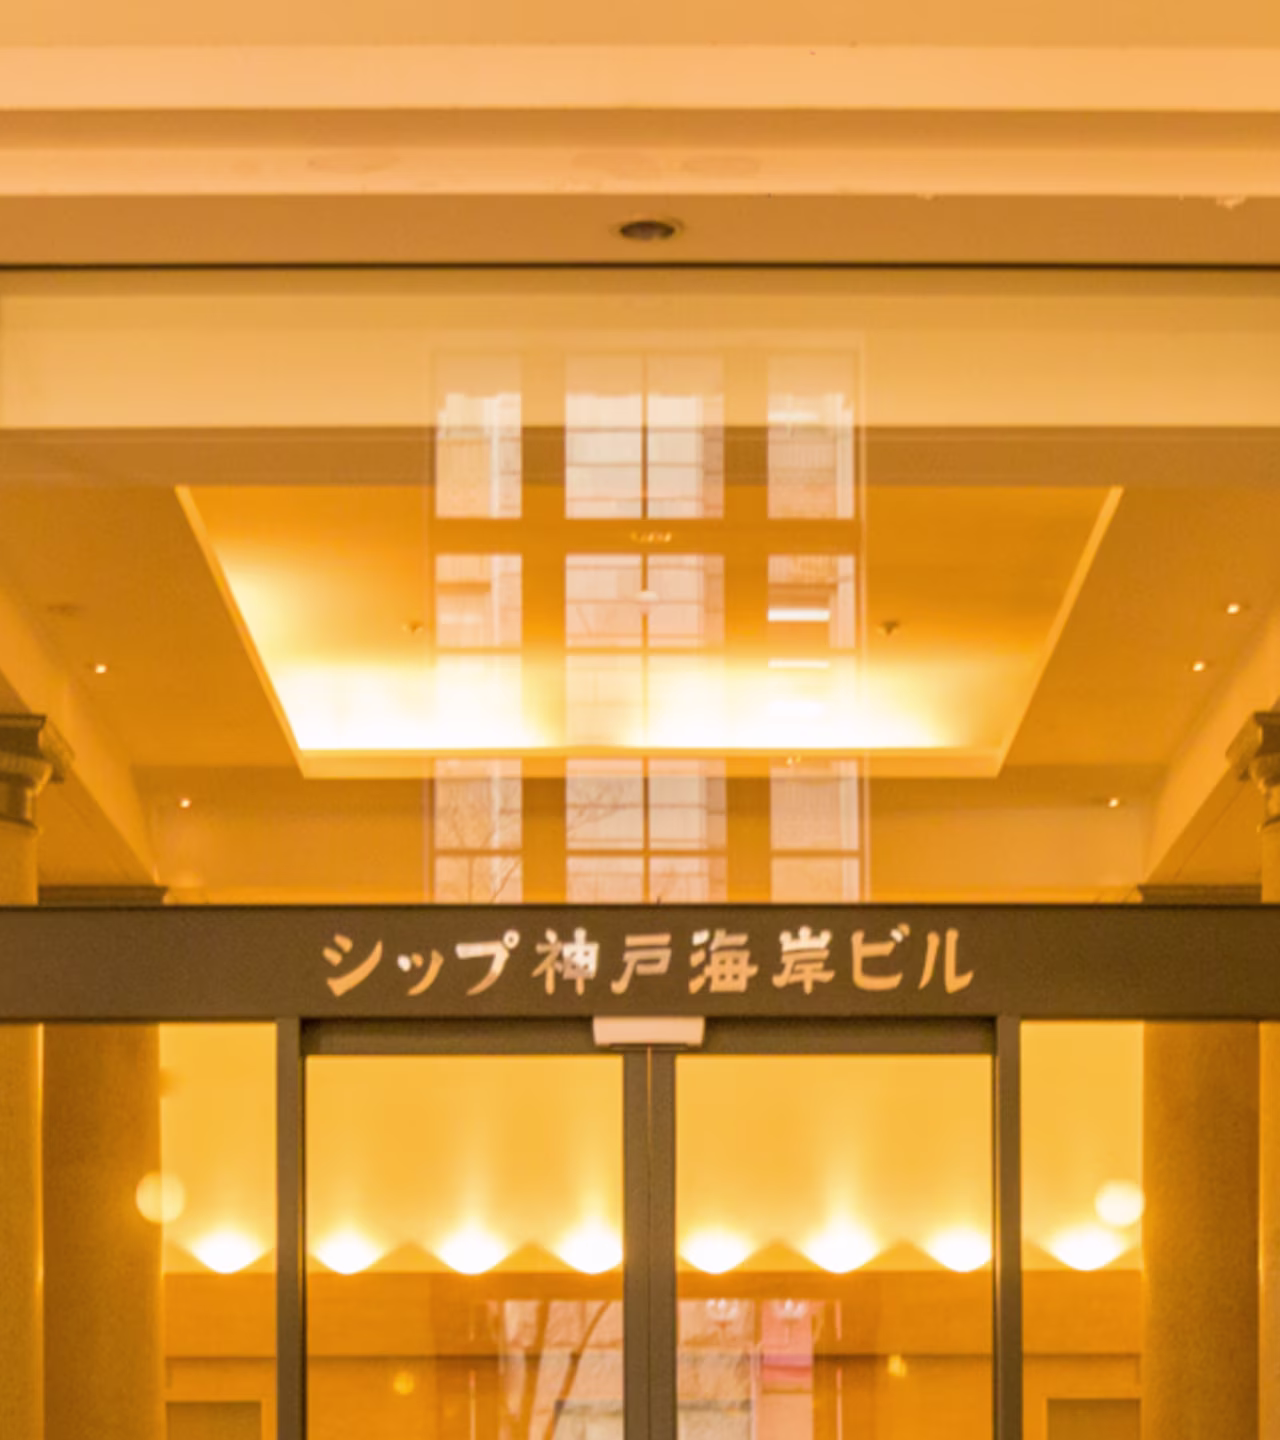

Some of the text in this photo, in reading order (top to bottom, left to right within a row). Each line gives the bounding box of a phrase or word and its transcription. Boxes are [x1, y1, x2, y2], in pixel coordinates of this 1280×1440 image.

[321, 923, 974, 997] シップ神戸海岸ビル
